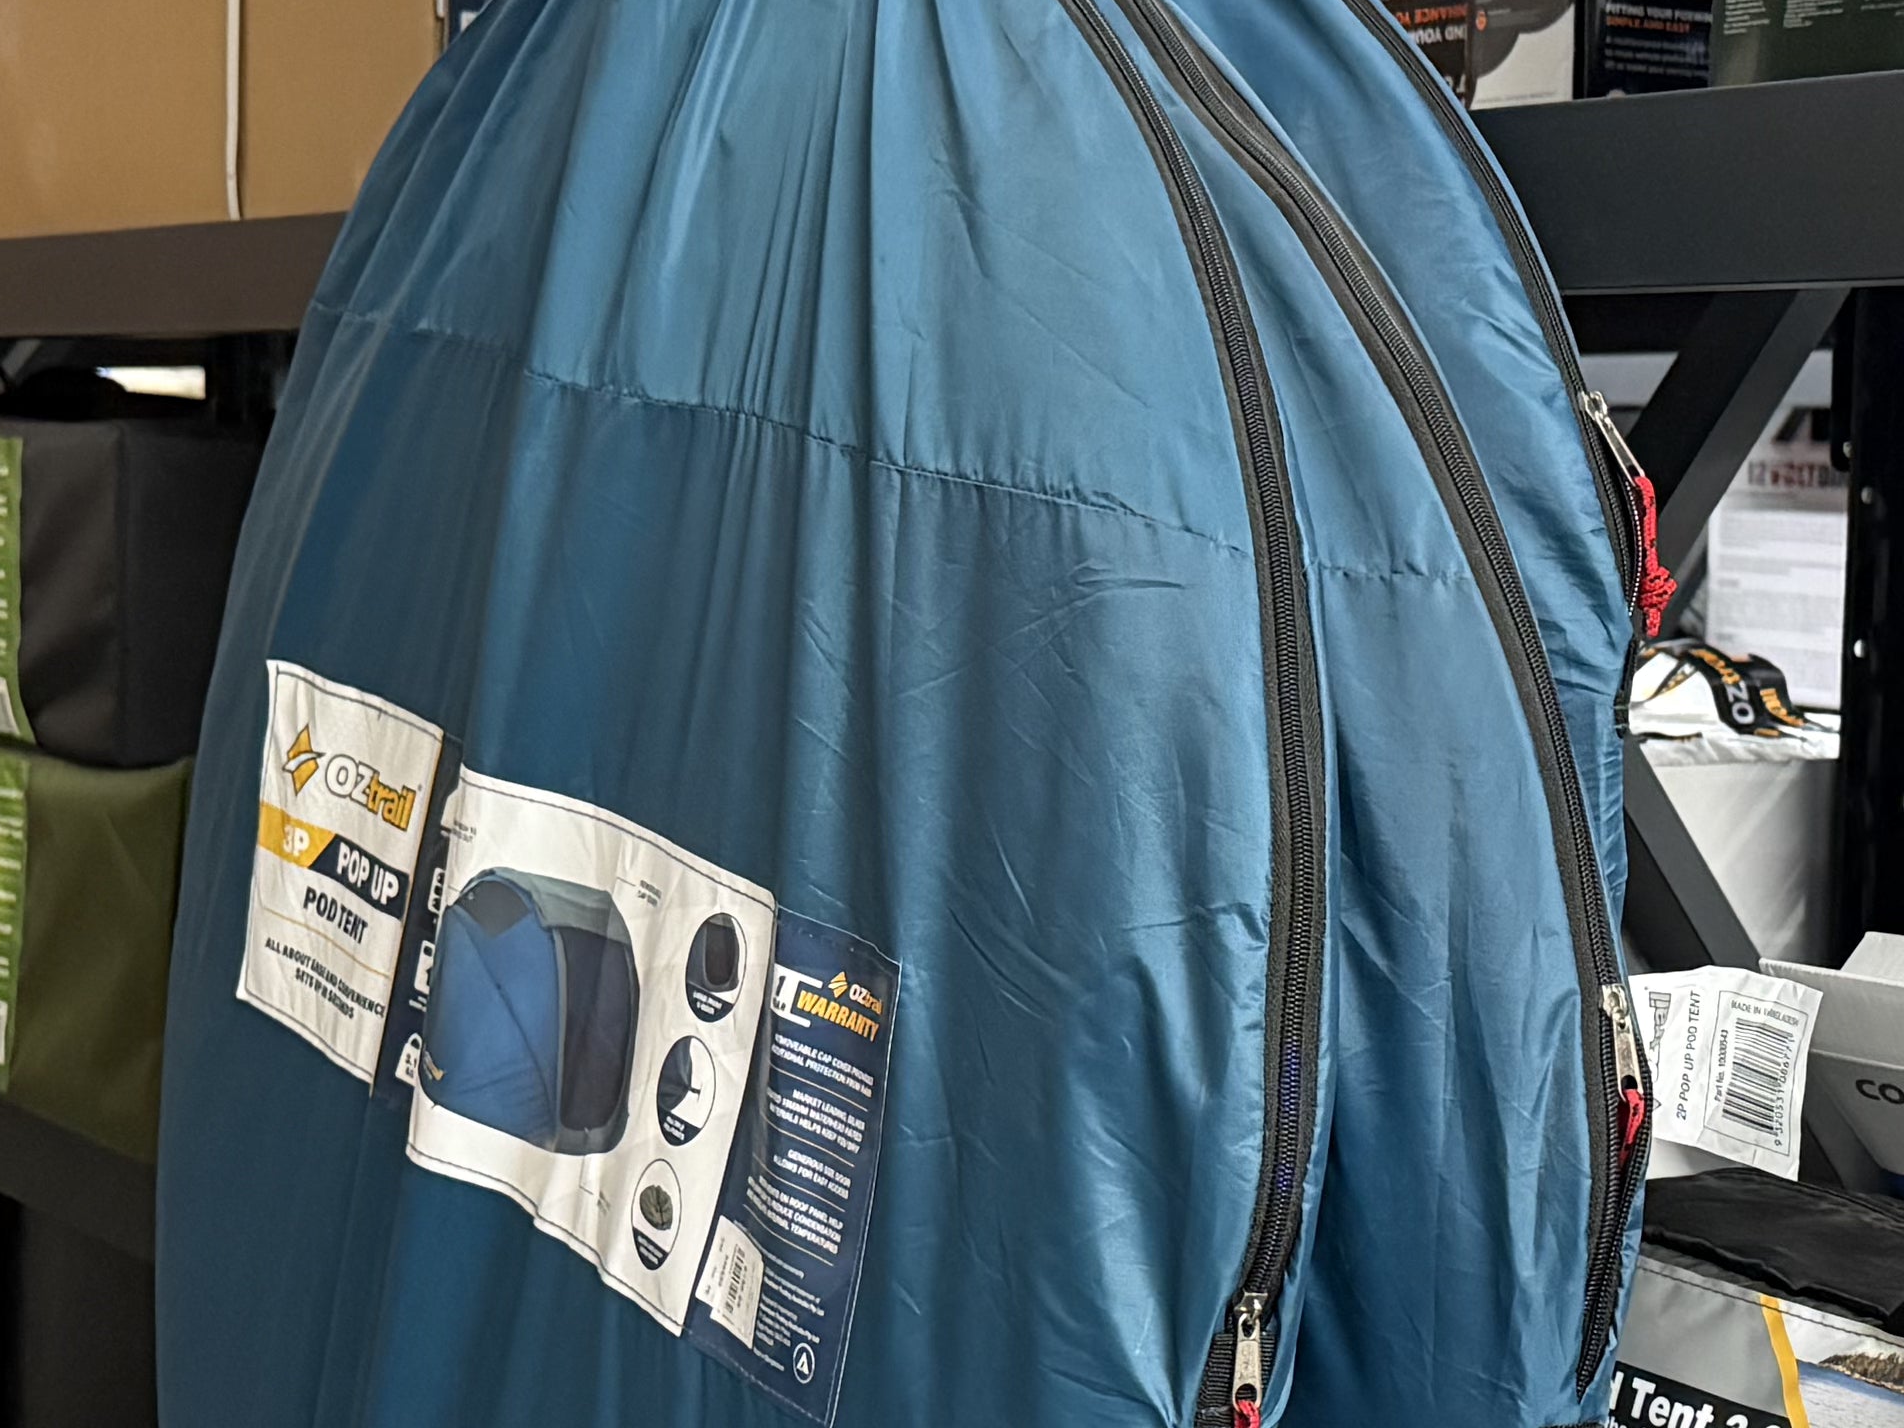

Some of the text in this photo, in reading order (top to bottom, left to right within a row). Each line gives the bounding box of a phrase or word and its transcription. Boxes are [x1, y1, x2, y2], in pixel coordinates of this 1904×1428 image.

[325, 754, 416, 832] OZtrail
[337, 842, 399, 906] POP UP
[303, 887, 368, 945] POD TENT
[796, 990, 880, 1042] WARRANTY
[1731, 1000, 1751, 1013] MADE
[1677, 990, 1701, 1120] 2P POP UP POD TENT
